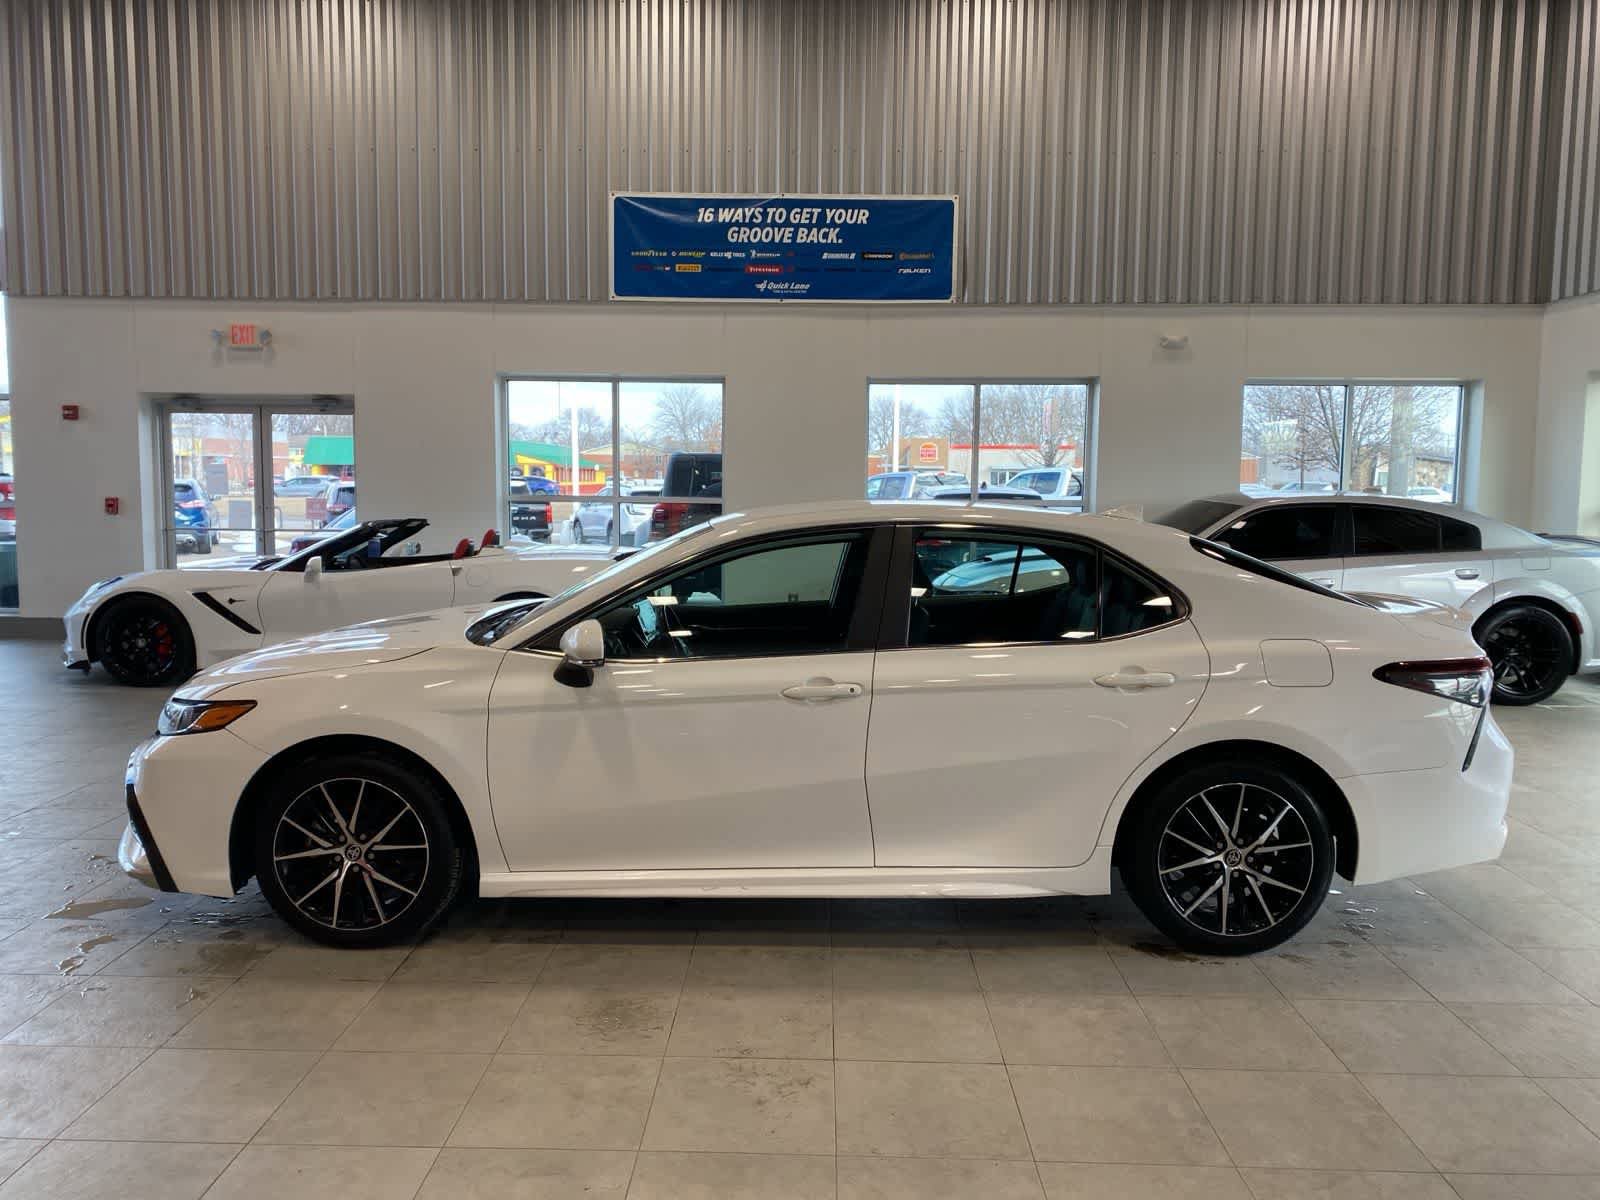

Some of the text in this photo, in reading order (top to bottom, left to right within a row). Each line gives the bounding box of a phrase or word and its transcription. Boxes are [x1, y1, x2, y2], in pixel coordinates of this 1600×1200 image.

[697, 208, 870, 225] 16 WAYS TO GET YOUR
[727, 227, 843, 244] GROOVE BACK.
[767, 281, 810, 290] Quick Lane
[231, 324, 257, 344] EXIT
